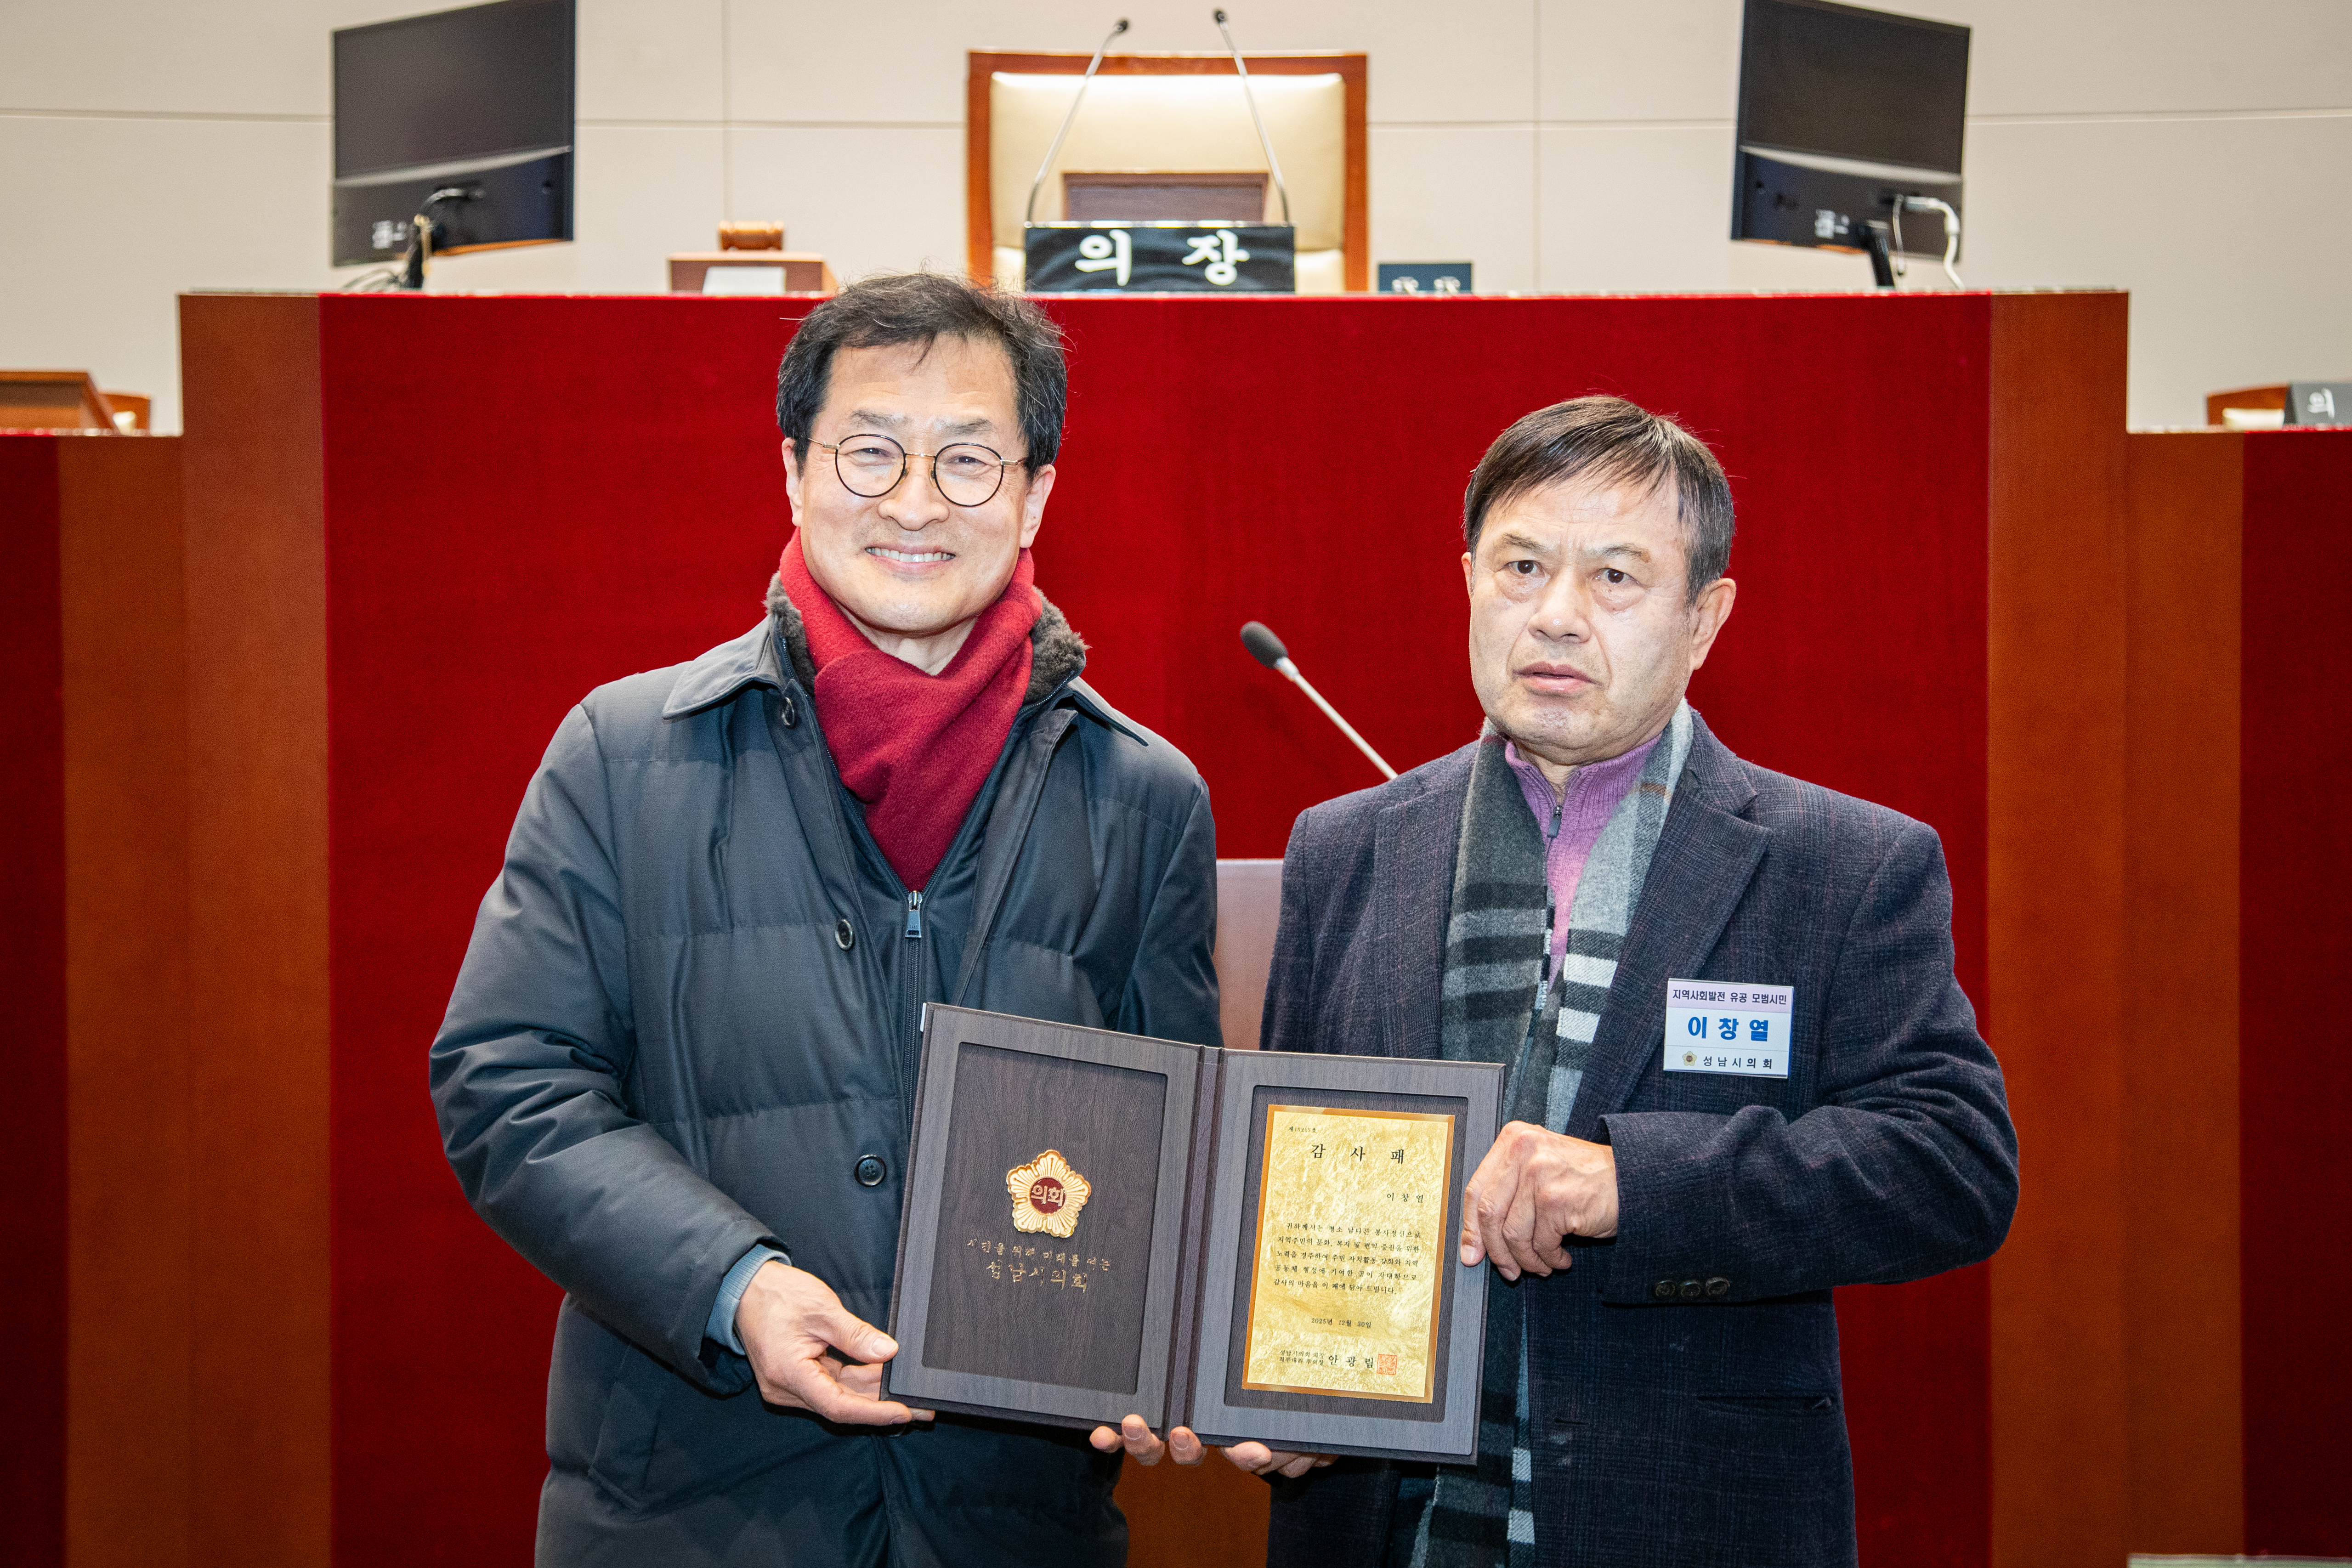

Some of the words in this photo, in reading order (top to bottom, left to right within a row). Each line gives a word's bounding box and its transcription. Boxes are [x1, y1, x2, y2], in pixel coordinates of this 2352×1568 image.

[1672, 989, 1725, 1002] 지역사회발전
[1730, 992, 1747, 1003] 유공
[1752, 994, 1787, 1005] 모범시민
[1688, 1017, 1768, 1042] 이창열
[1703, 1056, 1772, 1069] 성남시의회
[1031, 1184, 1065, 1207] 의회
[1287, 1223, 1323, 1232] 귀하께서는
[1375, 1229, 1421, 1238] 봉사정신으로
[1278, 1236, 1313, 1245] 지역주민의
